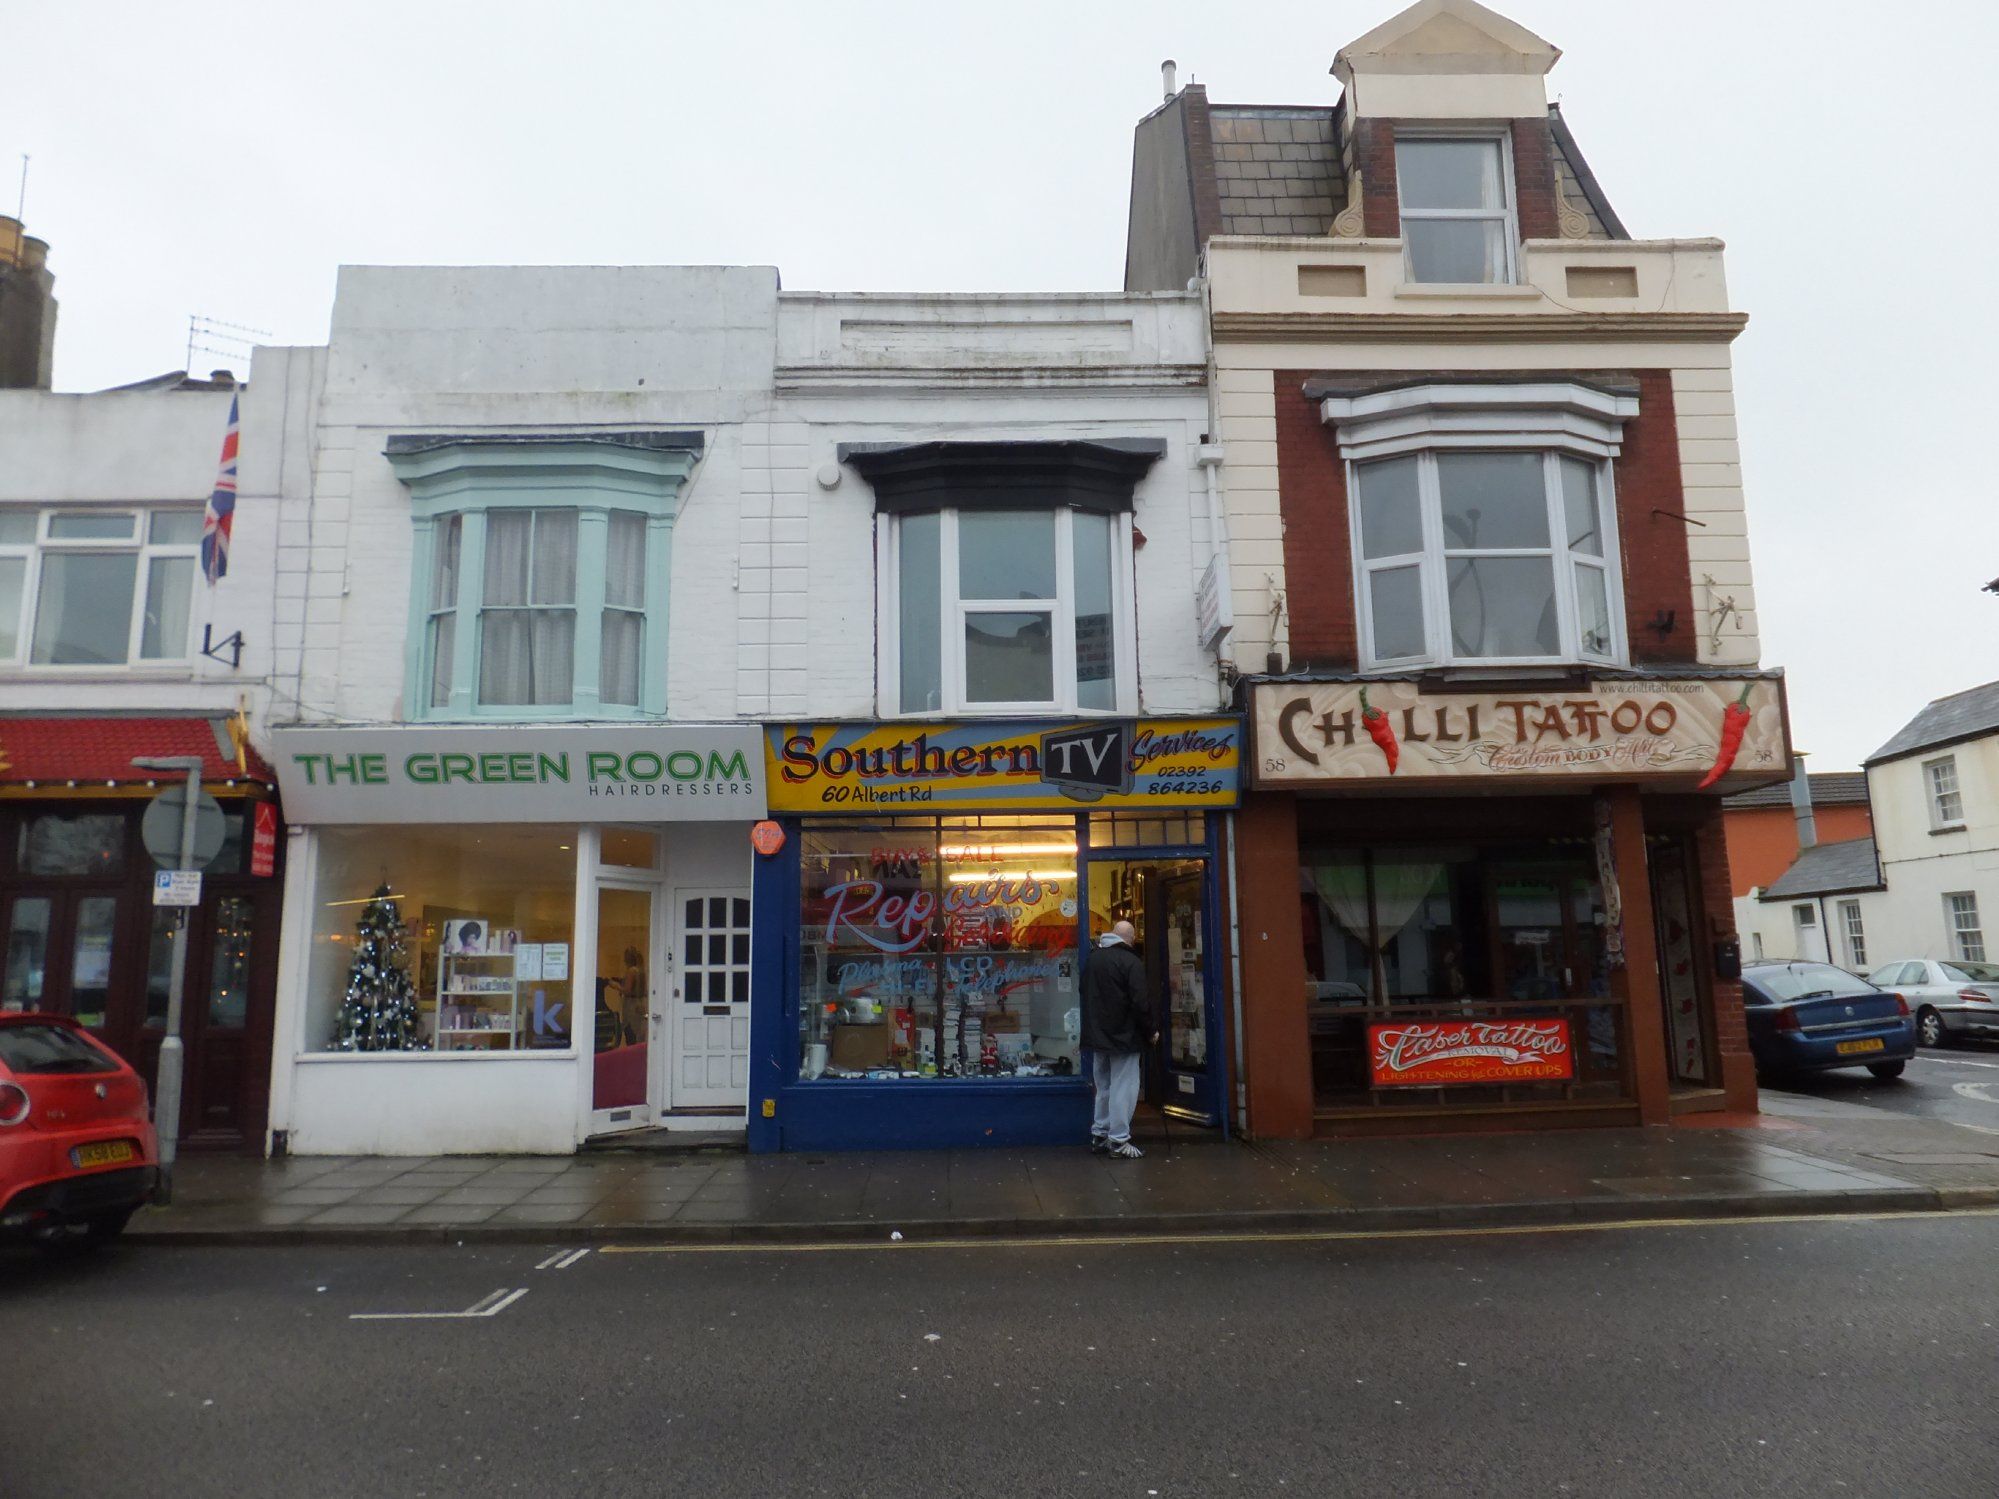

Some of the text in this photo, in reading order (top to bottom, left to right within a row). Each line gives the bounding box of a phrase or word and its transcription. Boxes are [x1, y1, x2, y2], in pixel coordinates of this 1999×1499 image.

[1599, 682, 1704, 694] www.chillitattoo.com
[1495, 699, 1677, 745] TATTOO
[781, 728, 1235, 783] Southern TV Services
[1565, 746, 1612, 763] BODY
[1753, 749, 1774, 763] 58
[292, 749, 752, 786] THE GREEN ROOM
[1157, 766, 1207, 778] 02392
[1265, 758, 1286, 773] 58
[589, 783, 754, 796] HAIRDRESSERS
[821, 785, 933, 803] 60 Albert Rd
[1147, 780, 1223, 796] 864236
[824, 868, 1060, 954] Repairs
[947, 956, 993, 972] LCD
[1377, 1022, 1567, 1072] Laser Tattoo
[1380, 1069, 1470, 1081] LIGHTENING
[1486, 1067, 1535, 1078] COVER
[1536, 1064, 1564, 1076] UPS
